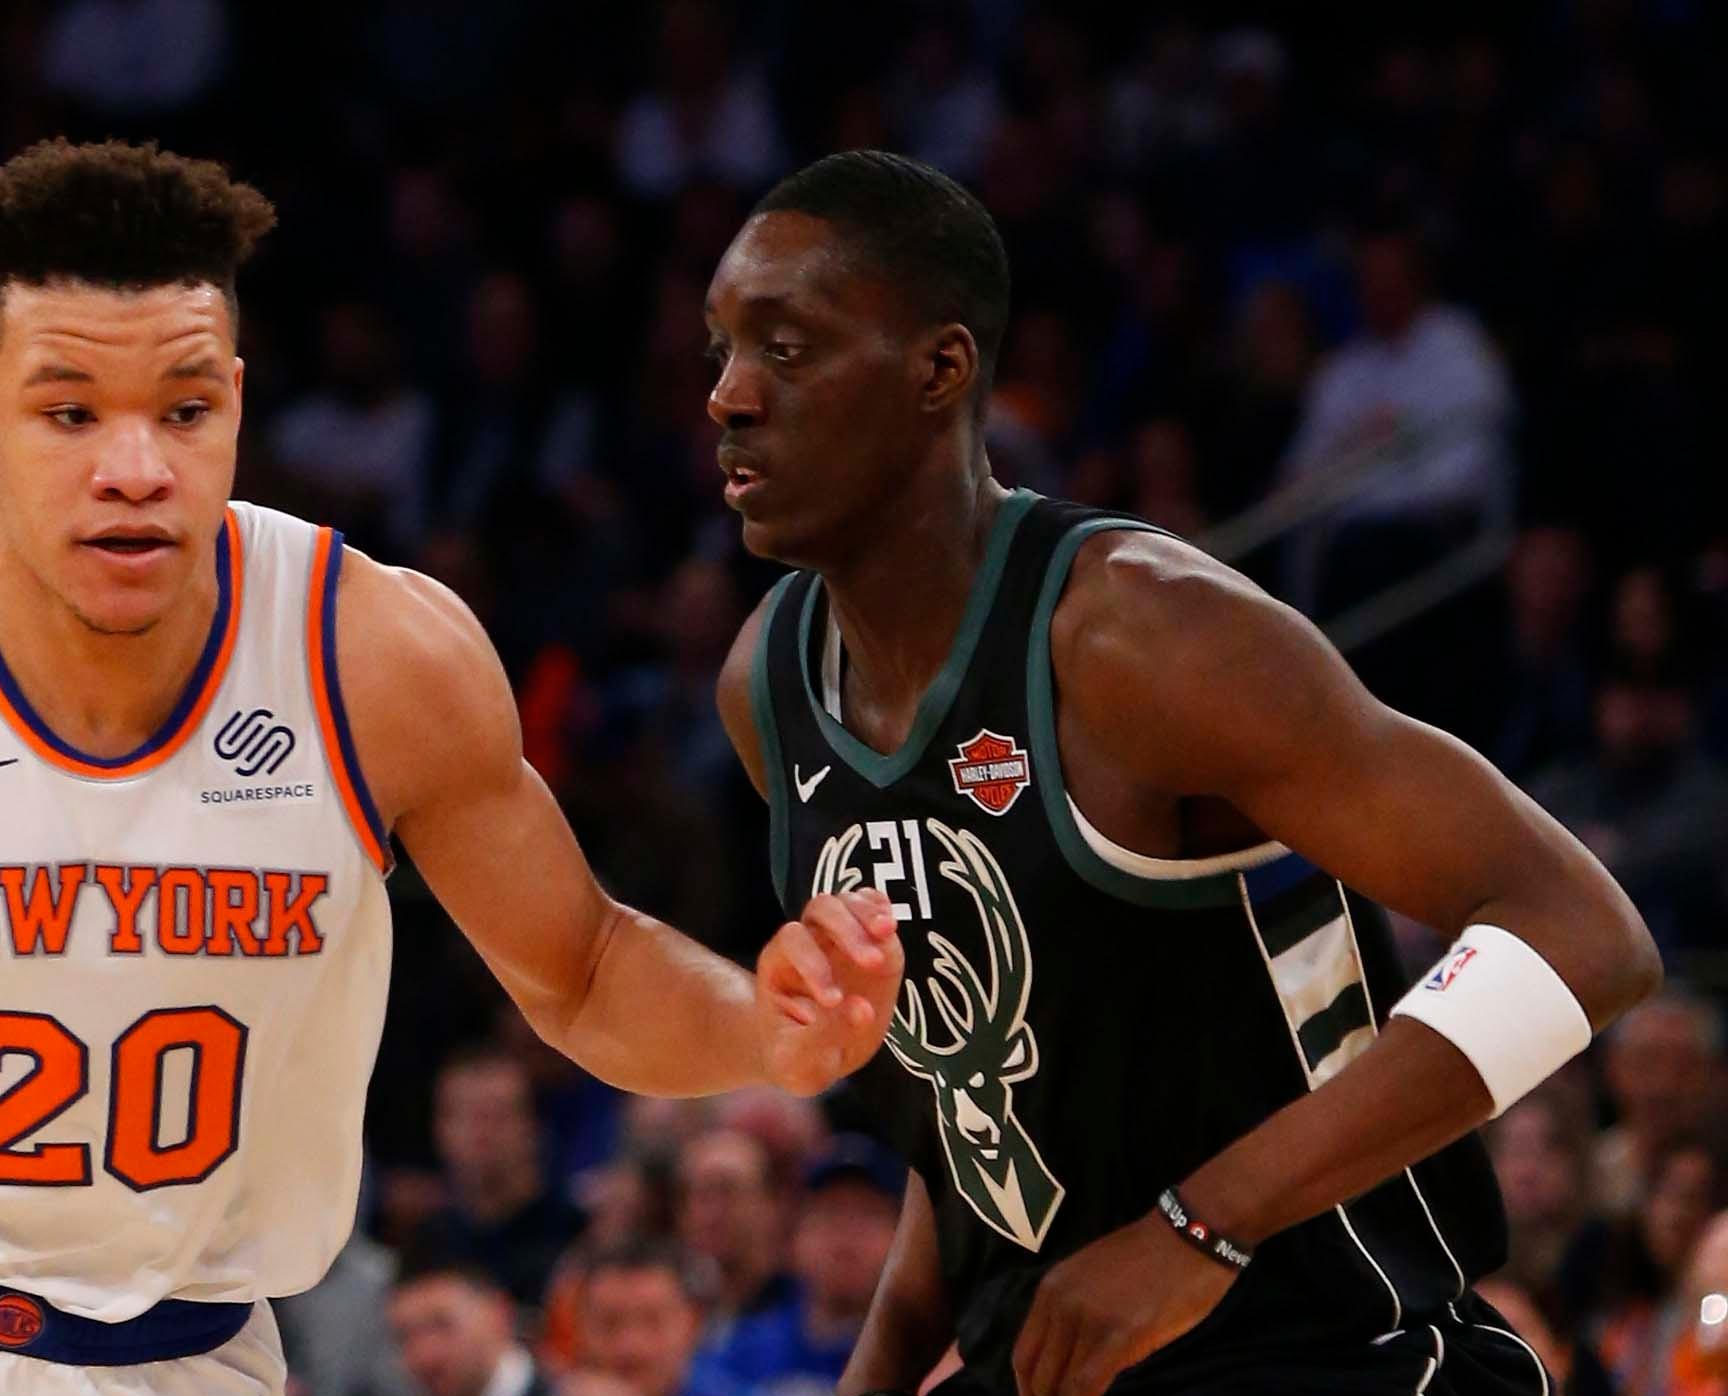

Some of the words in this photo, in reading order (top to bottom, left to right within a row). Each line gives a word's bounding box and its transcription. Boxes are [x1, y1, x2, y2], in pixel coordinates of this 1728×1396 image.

[200, 784, 314, 804] SQUARESPACE
[94, 863, 330, 958] YORK
[866, 819, 933, 921] 21
